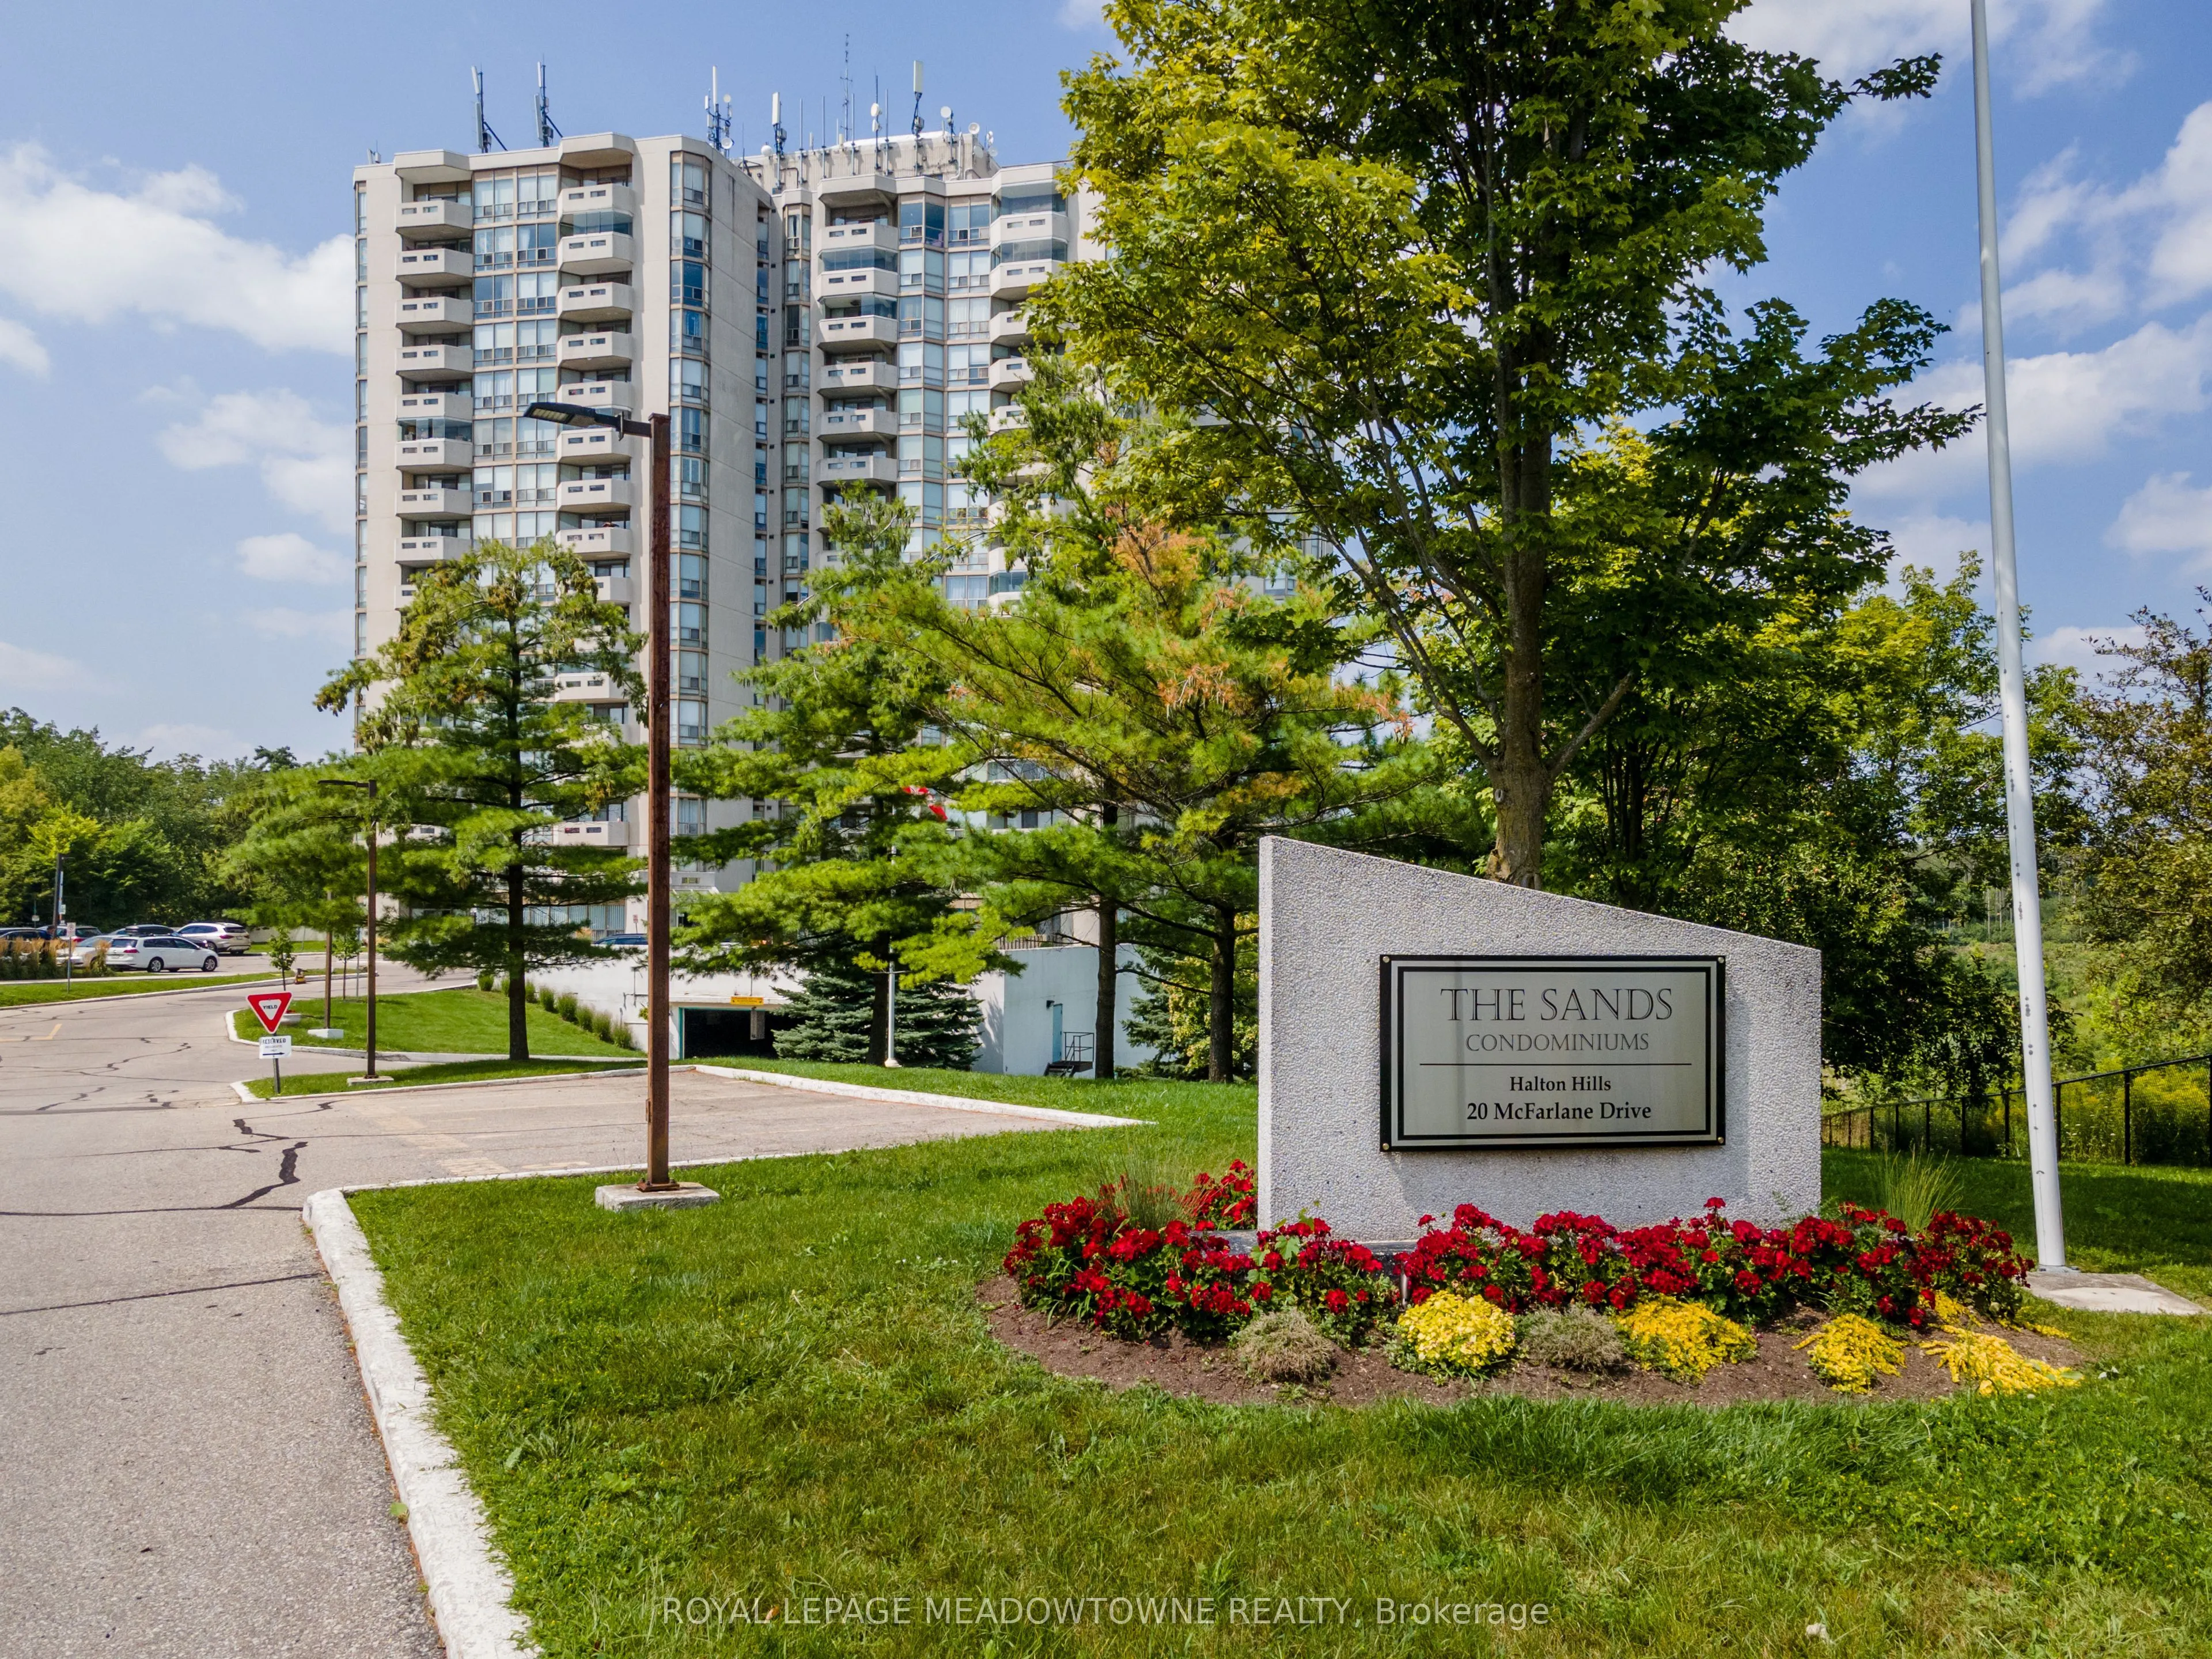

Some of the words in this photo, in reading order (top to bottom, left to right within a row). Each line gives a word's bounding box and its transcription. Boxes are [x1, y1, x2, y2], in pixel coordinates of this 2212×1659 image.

[1440, 988, 1525, 1021] THE
[1540, 988, 1672, 1021] SANDS
[1465, 1033, 1649, 1051] CONDOMINIUMS
[1510, 1076, 1566, 1091] Halton
[1571, 1076, 1611, 1091] Hills
[1467, 1103, 1488, 1120] 20
[1494, 1103, 1593, 1120] McFarlane
[1600, 1101, 1652, 1119] Drive
